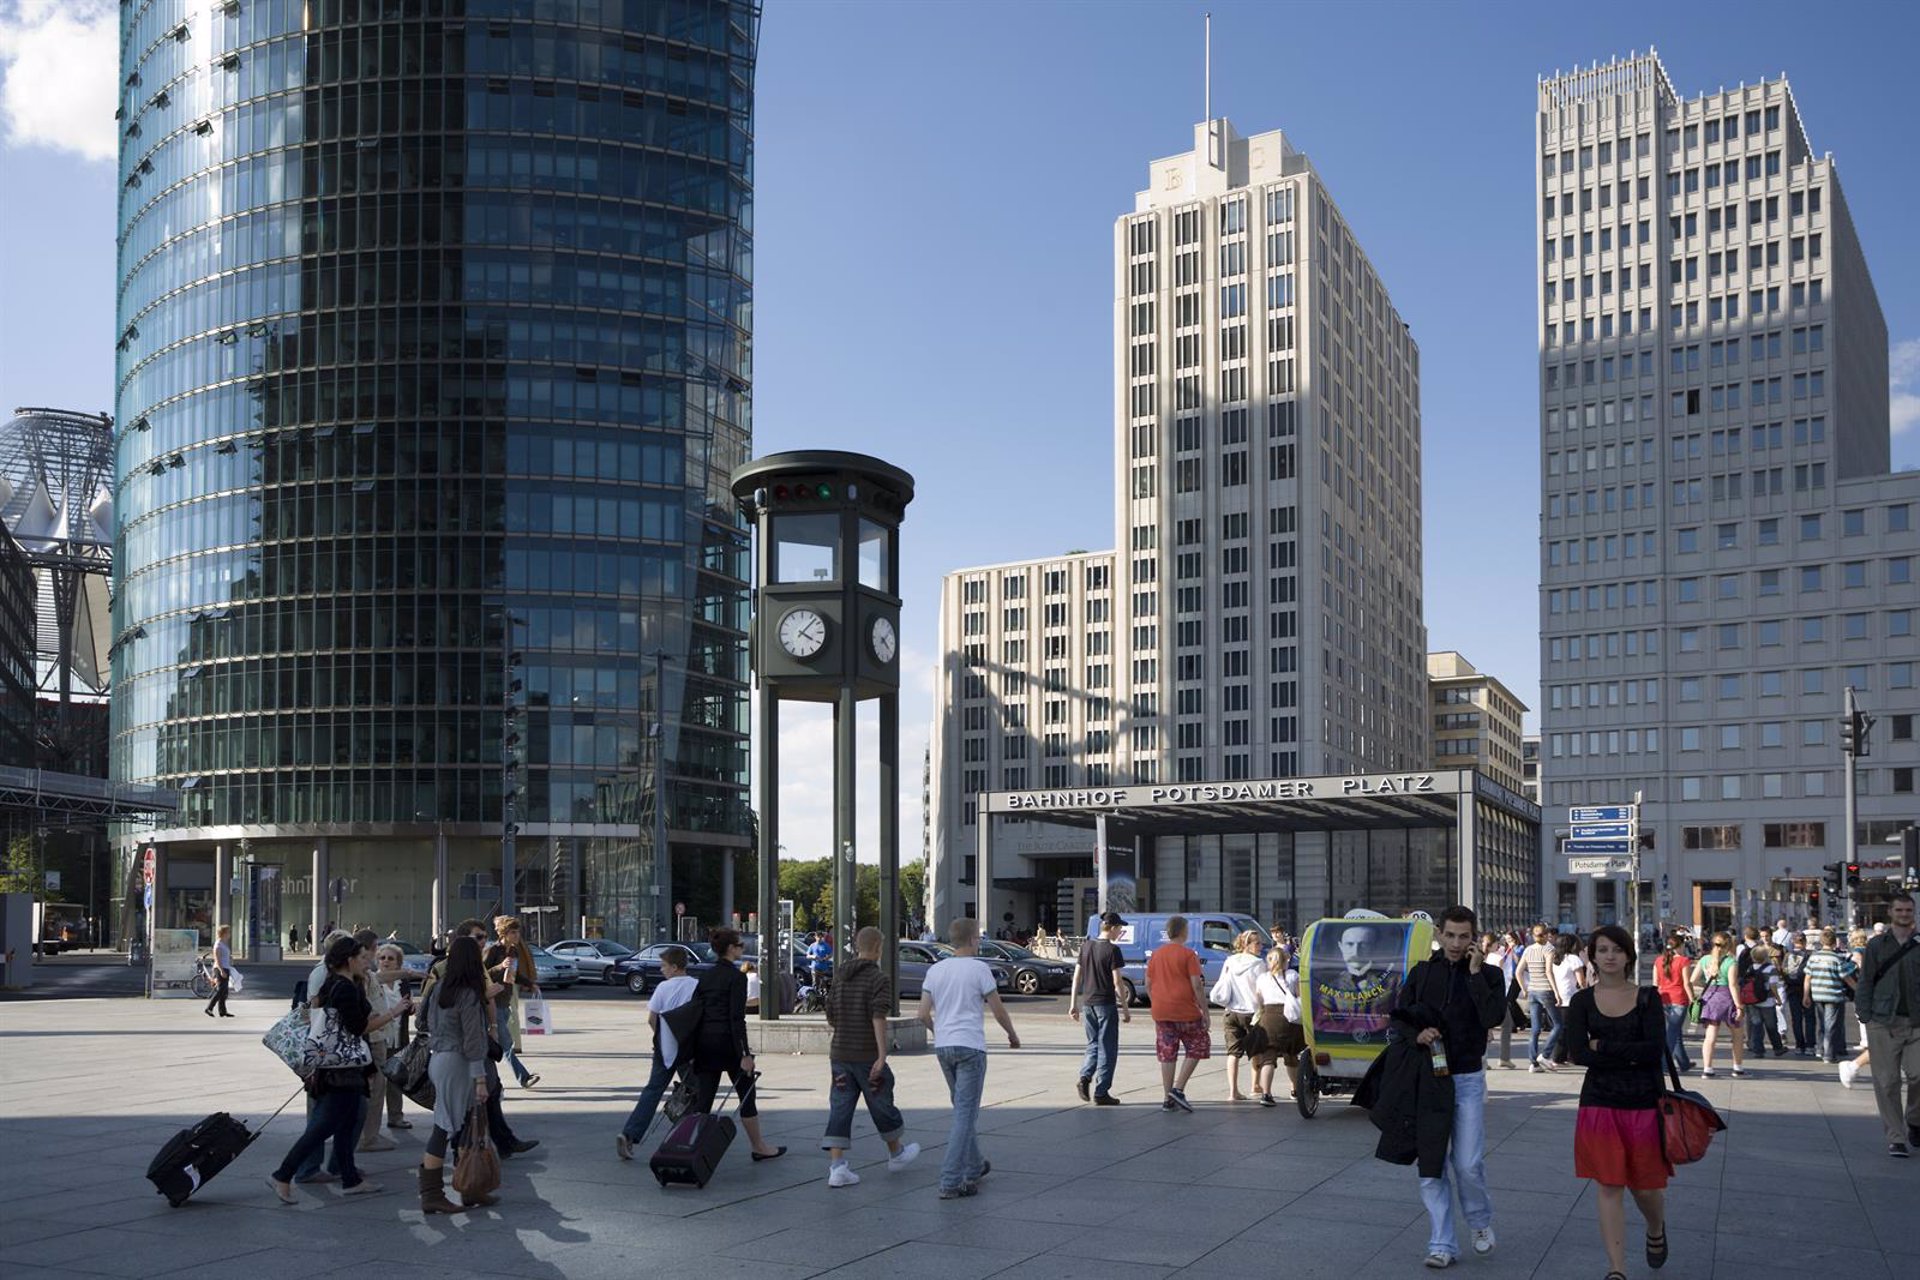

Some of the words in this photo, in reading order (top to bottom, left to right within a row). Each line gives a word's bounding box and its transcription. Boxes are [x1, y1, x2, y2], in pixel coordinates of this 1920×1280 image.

[1007, 789, 1127, 808] BAHNHOF
[1150, 781, 1312, 803] POTSDAMER
[1342, 775, 1434, 794] PLATZ
[1319, 983, 1341, 998] MAX
[1343, 984, 1385, 1000] PLANCK
